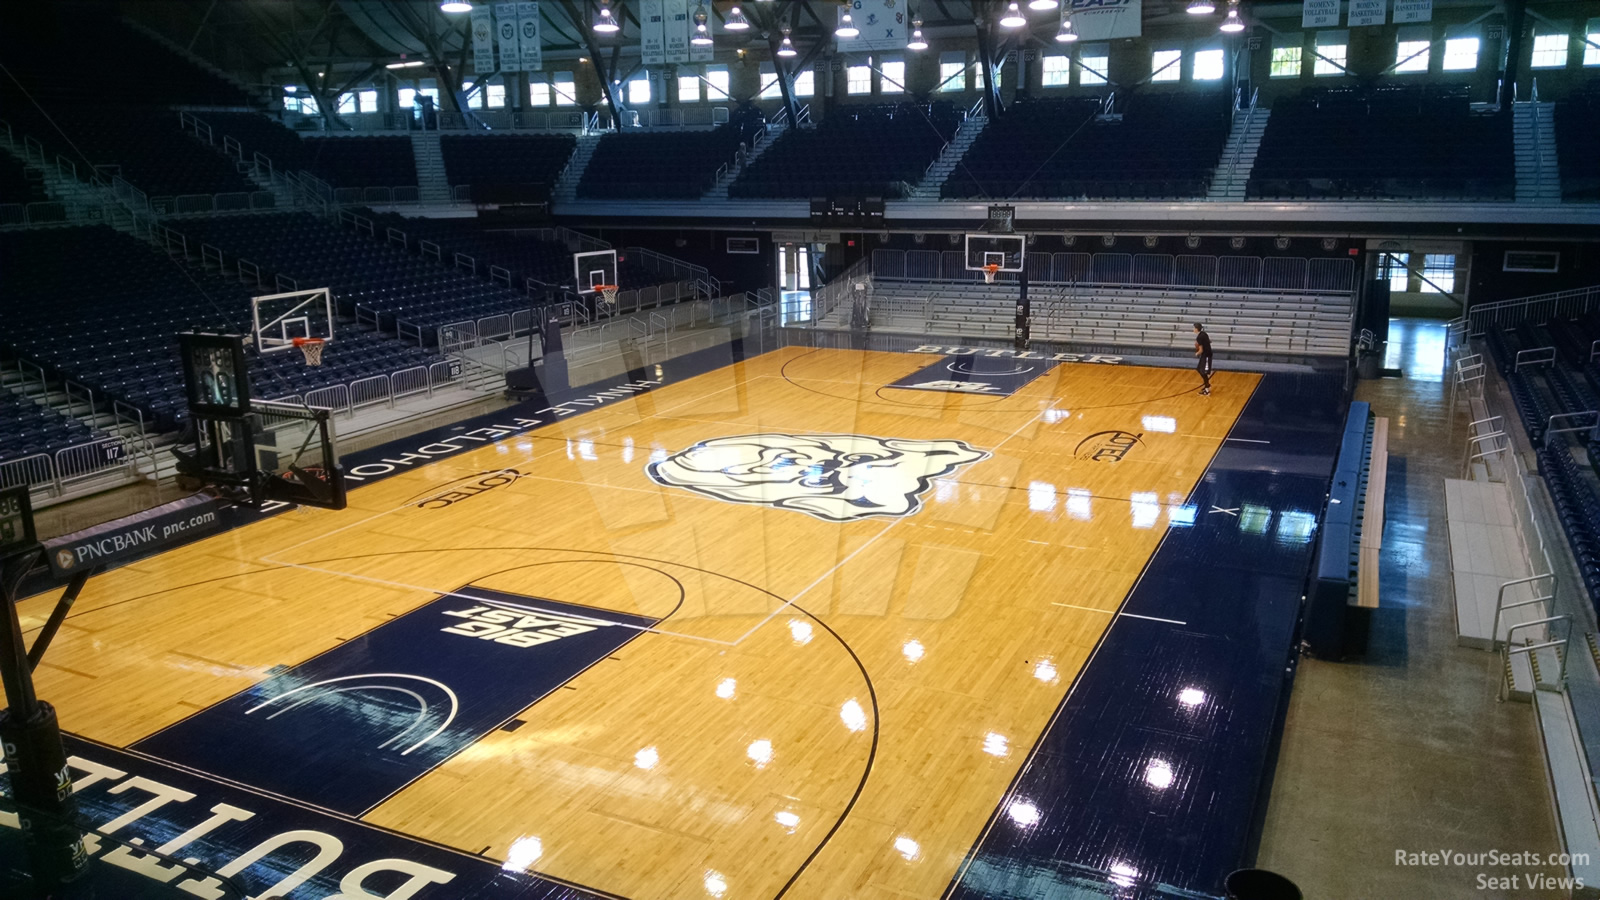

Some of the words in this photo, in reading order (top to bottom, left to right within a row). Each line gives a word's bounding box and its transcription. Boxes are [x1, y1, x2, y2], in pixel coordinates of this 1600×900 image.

[1395, 3, 1431, 11] BASKETBALL
[907, 345, 1123, 364] BUTLER
[535, 379, 661, 416] HINKLE
[102, 440, 122, 449] SECTION
[106, 446, 119, 460] 117
[162, 510, 216, 538] pnc.com
[440, 620, 562, 648] BIG
[441, 605, 598, 638] EAST
[0, 740, 458, 900] BUTLE
